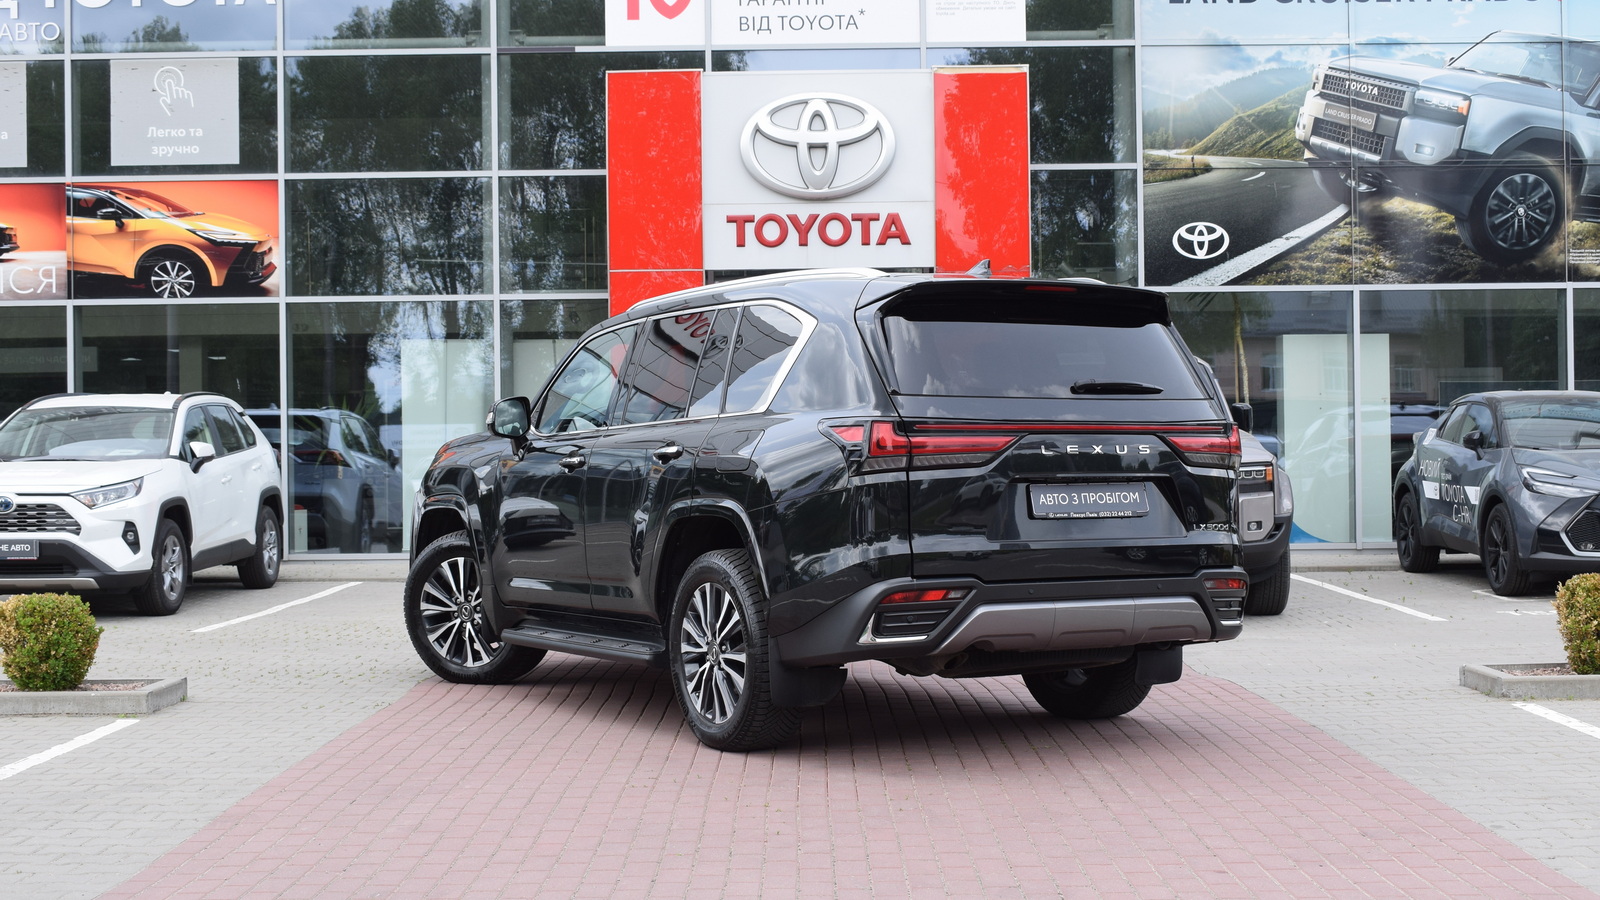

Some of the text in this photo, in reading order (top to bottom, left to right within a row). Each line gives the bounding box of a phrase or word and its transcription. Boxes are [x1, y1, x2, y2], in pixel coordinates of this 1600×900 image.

[738, 16, 772, 34] ВІД
[1345, 81, 1379, 96] TOYOTA
[147, 127, 203, 139] Легко та
[151, 144, 200, 157] зручно
[726, 212, 912, 248] TOYOTA
[0, 265, 57, 294] СЯ
[1041, 444, 1151, 455] LEXUS
[1418, 458, 1441, 478] НОВИЙ
[1039, 491, 1140, 505] АВТО З ПРОБІГОМ
[1441, 483, 1466, 503] TOYOTA
[10, 544, 31, 552] АВТО
